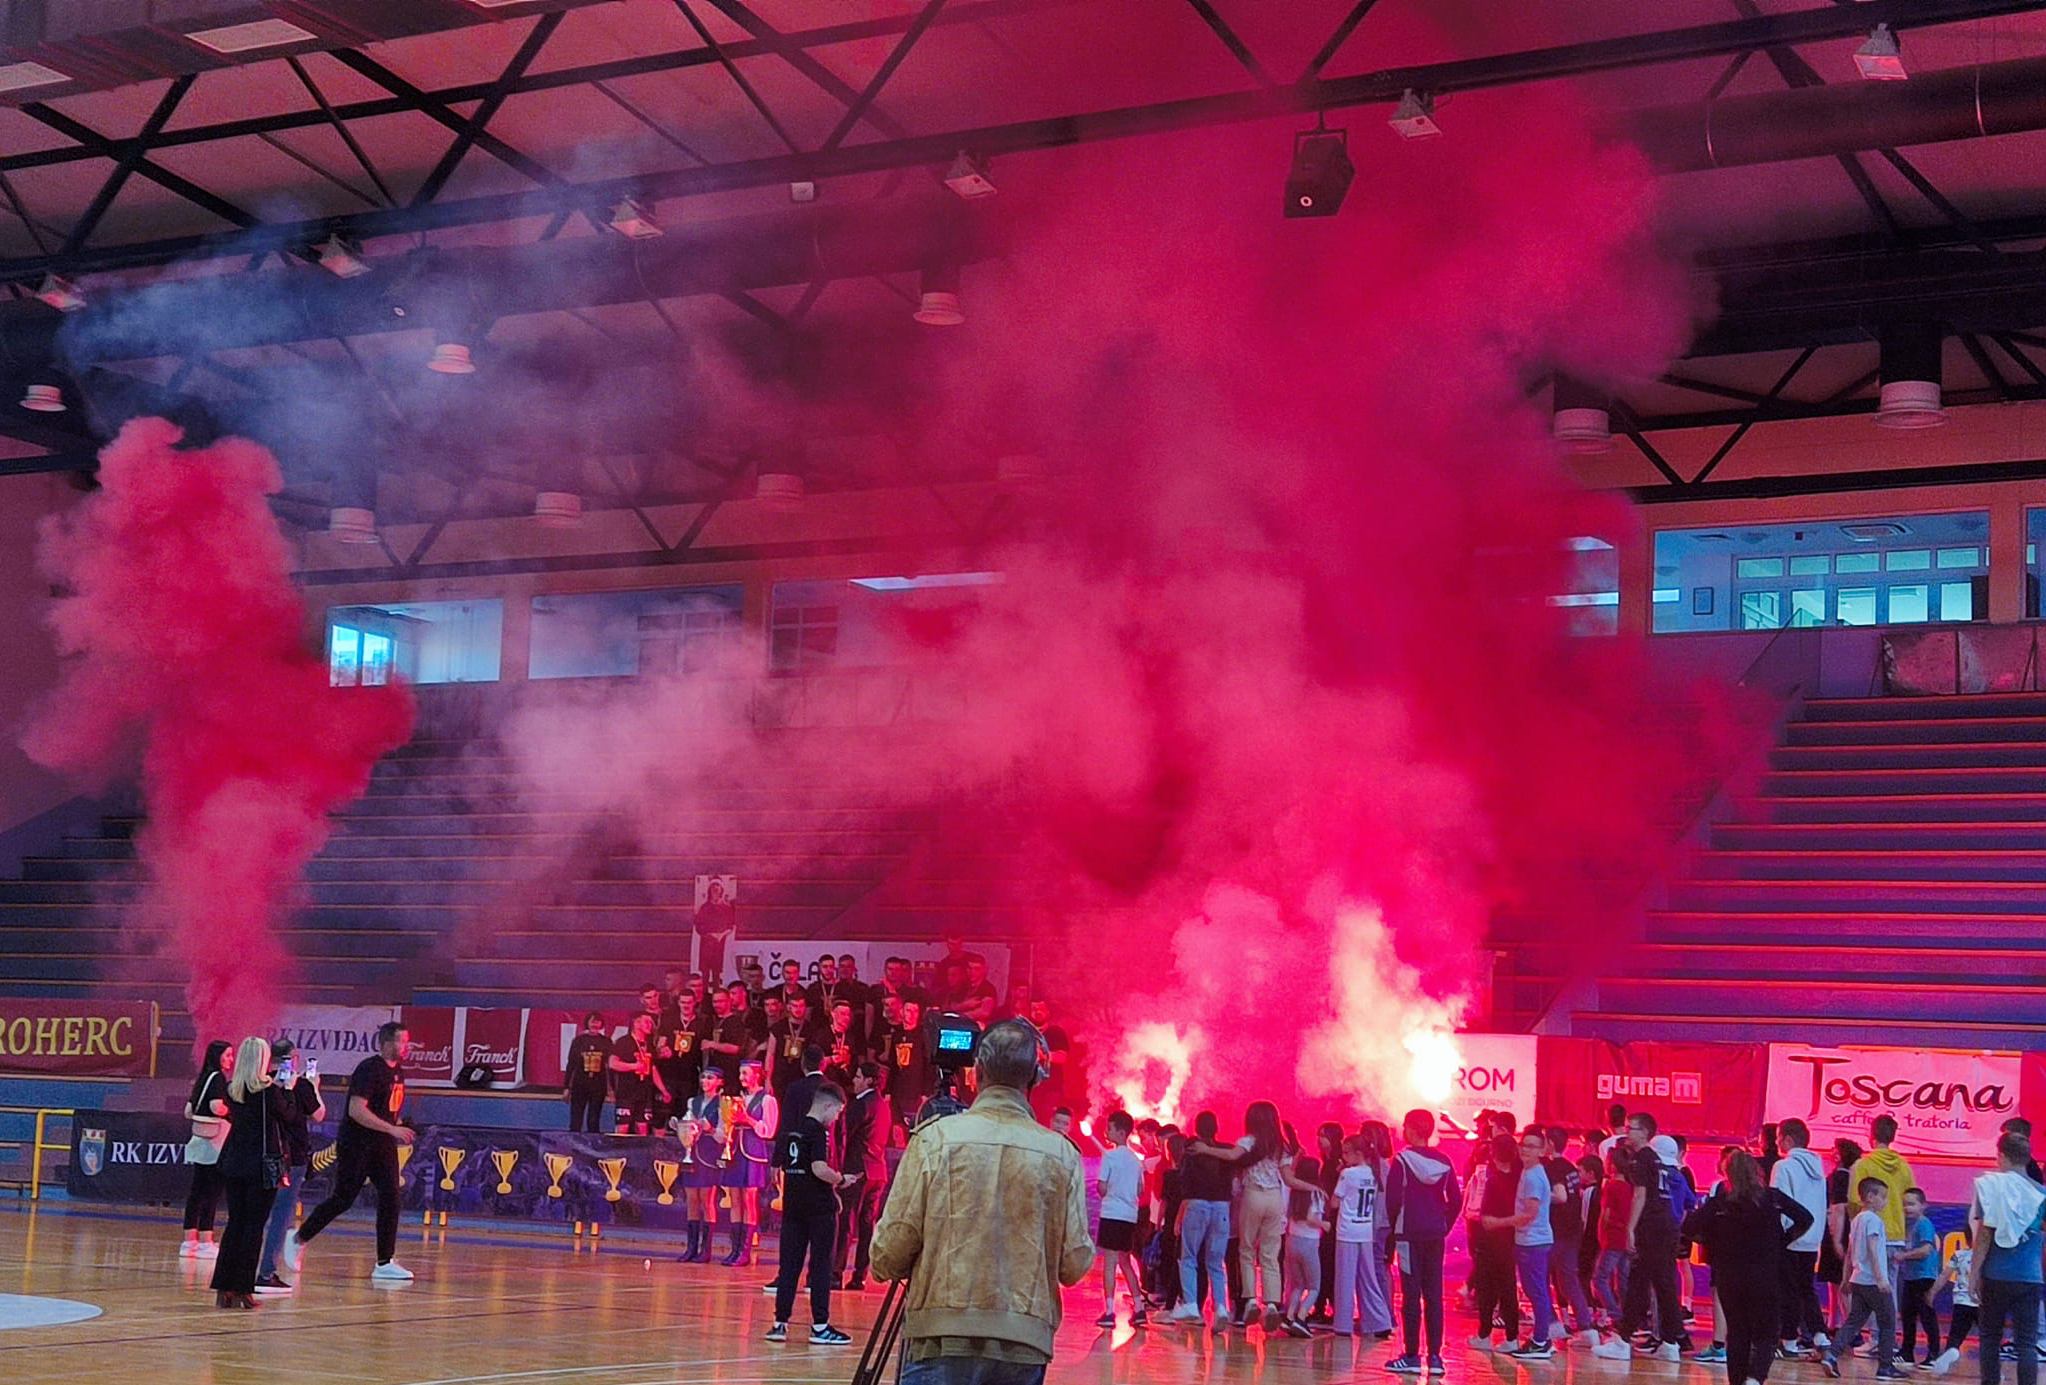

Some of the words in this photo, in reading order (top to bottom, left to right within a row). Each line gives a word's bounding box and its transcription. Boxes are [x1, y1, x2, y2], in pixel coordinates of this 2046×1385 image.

[0, 1017, 132, 1056] OHERC
[464, 1043, 518, 1065] Franck
[1788, 1055, 2014, 1120] Toscana
[1904, 1114, 1972, 1131] tratoria
[111, 1141, 142, 1163] RK
[146, 1143, 194, 1165] IZVI
[789, 1142, 799, 1165] 9
